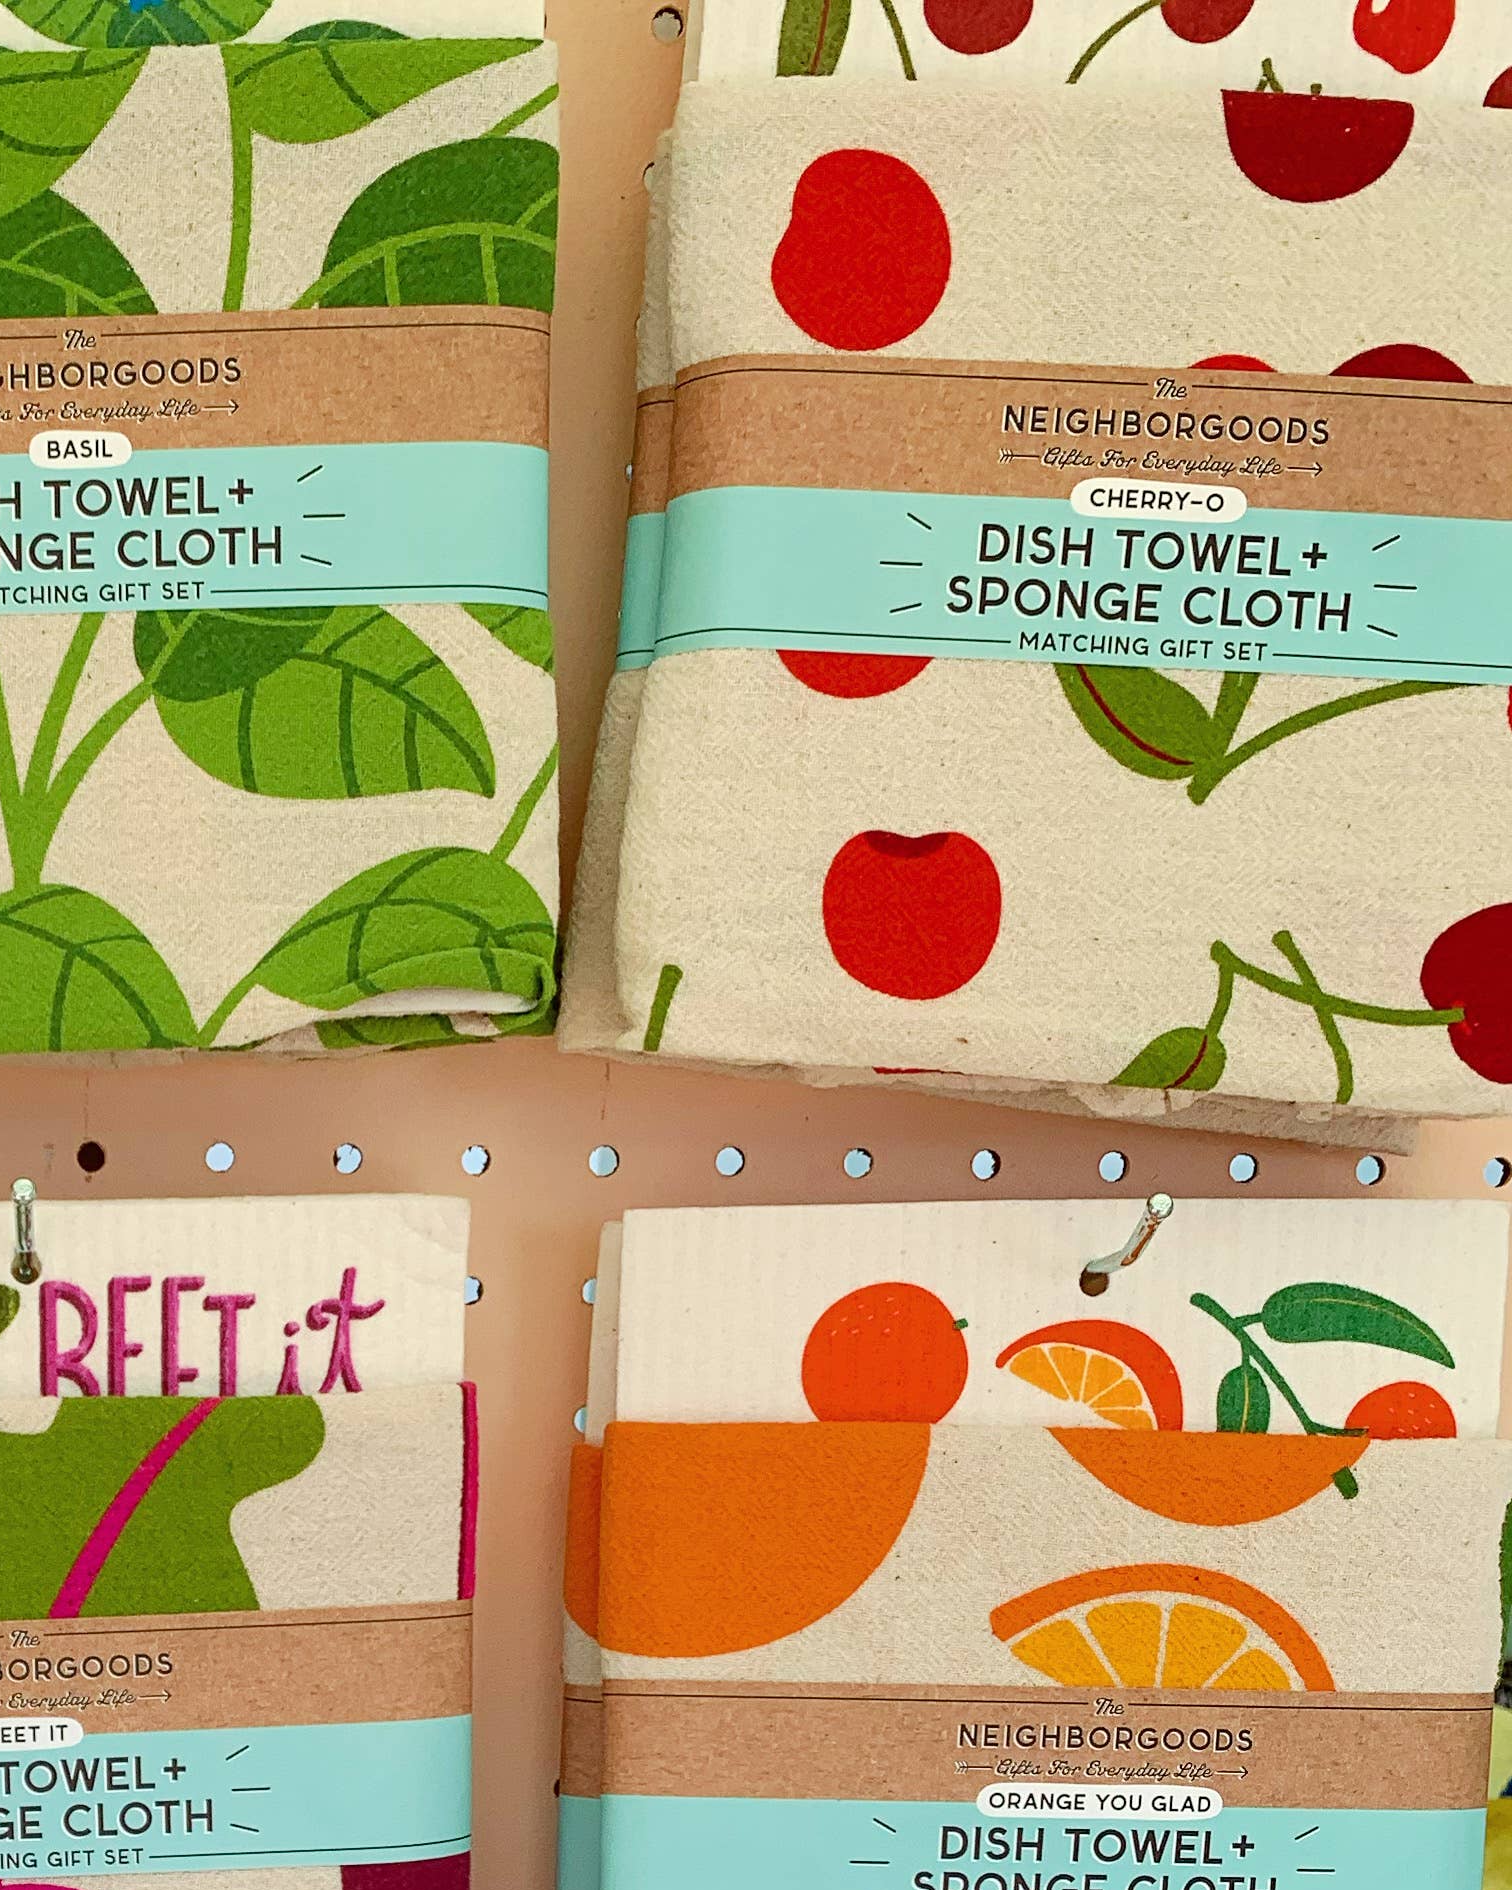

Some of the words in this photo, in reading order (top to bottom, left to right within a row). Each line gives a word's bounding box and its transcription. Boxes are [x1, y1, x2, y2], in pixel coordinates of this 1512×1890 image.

[65, 329, 97, 348] The
[1156, 377, 1188, 397] The
[19, 402, 55, 420] For
[60, 400, 154, 423] Everyday
[158, 397, 201, 420] Life
[1004, 404, 1329, 444] NEIGHBORGOODS
[47, 439, 113, 458] BASIL
[1043, 446, 1096, 469] Gifts
[1099, 448, 1138, 467] For
[1141, 450, 1237, 477] Everyday
[1239, 455, 1284, 478] Life
[1090, 488, 1224, 512] CHERRY-O
[117, 525, 282, 567] CLOTH
[979, 523, 1094, 566] DISH
[99, 582, 151, 601] GIFT
[162, 581, 205, 599] SET
[946, 575, 1163, 622] SPONGE
[1183, 586, 1352, 631] CLOTH
[1019, 631, 1149, 655] MATCHING
[1160, 638, 1214, 658] GIFT
[1223, 641, 1268, 660] SET
[11, 1629, 41, 1647] The
[8, 1690, 94, 1711] Everyday
[96, 1688, 137, 1707] Life
[1095, 1697, 1125, 1714] The
[50, 1724, 68, 1741] IT
[959, 1723, 1253, 1751] NEIGHBORGOODS
[996, 1758, 1043, 1778] Gifts
[1047, 1759, 1082, 1775] For
[1085, 1759, 1171, 1781] Everyday
[1173, 1761, 1214, 1781] Life
[989, 1792, 1086, 1810] ORANGE
[1095, 1794, 1142, 1810] YOU
[1151, 1795, 1211, 1812] GLAD
[63, 1798, 213, 1836] CLOTH
[940, 1825, 1045, 1861] DISH
[47, 1849, 95, 1866] GIFT
[104, 1847, 144, 1864] SET
